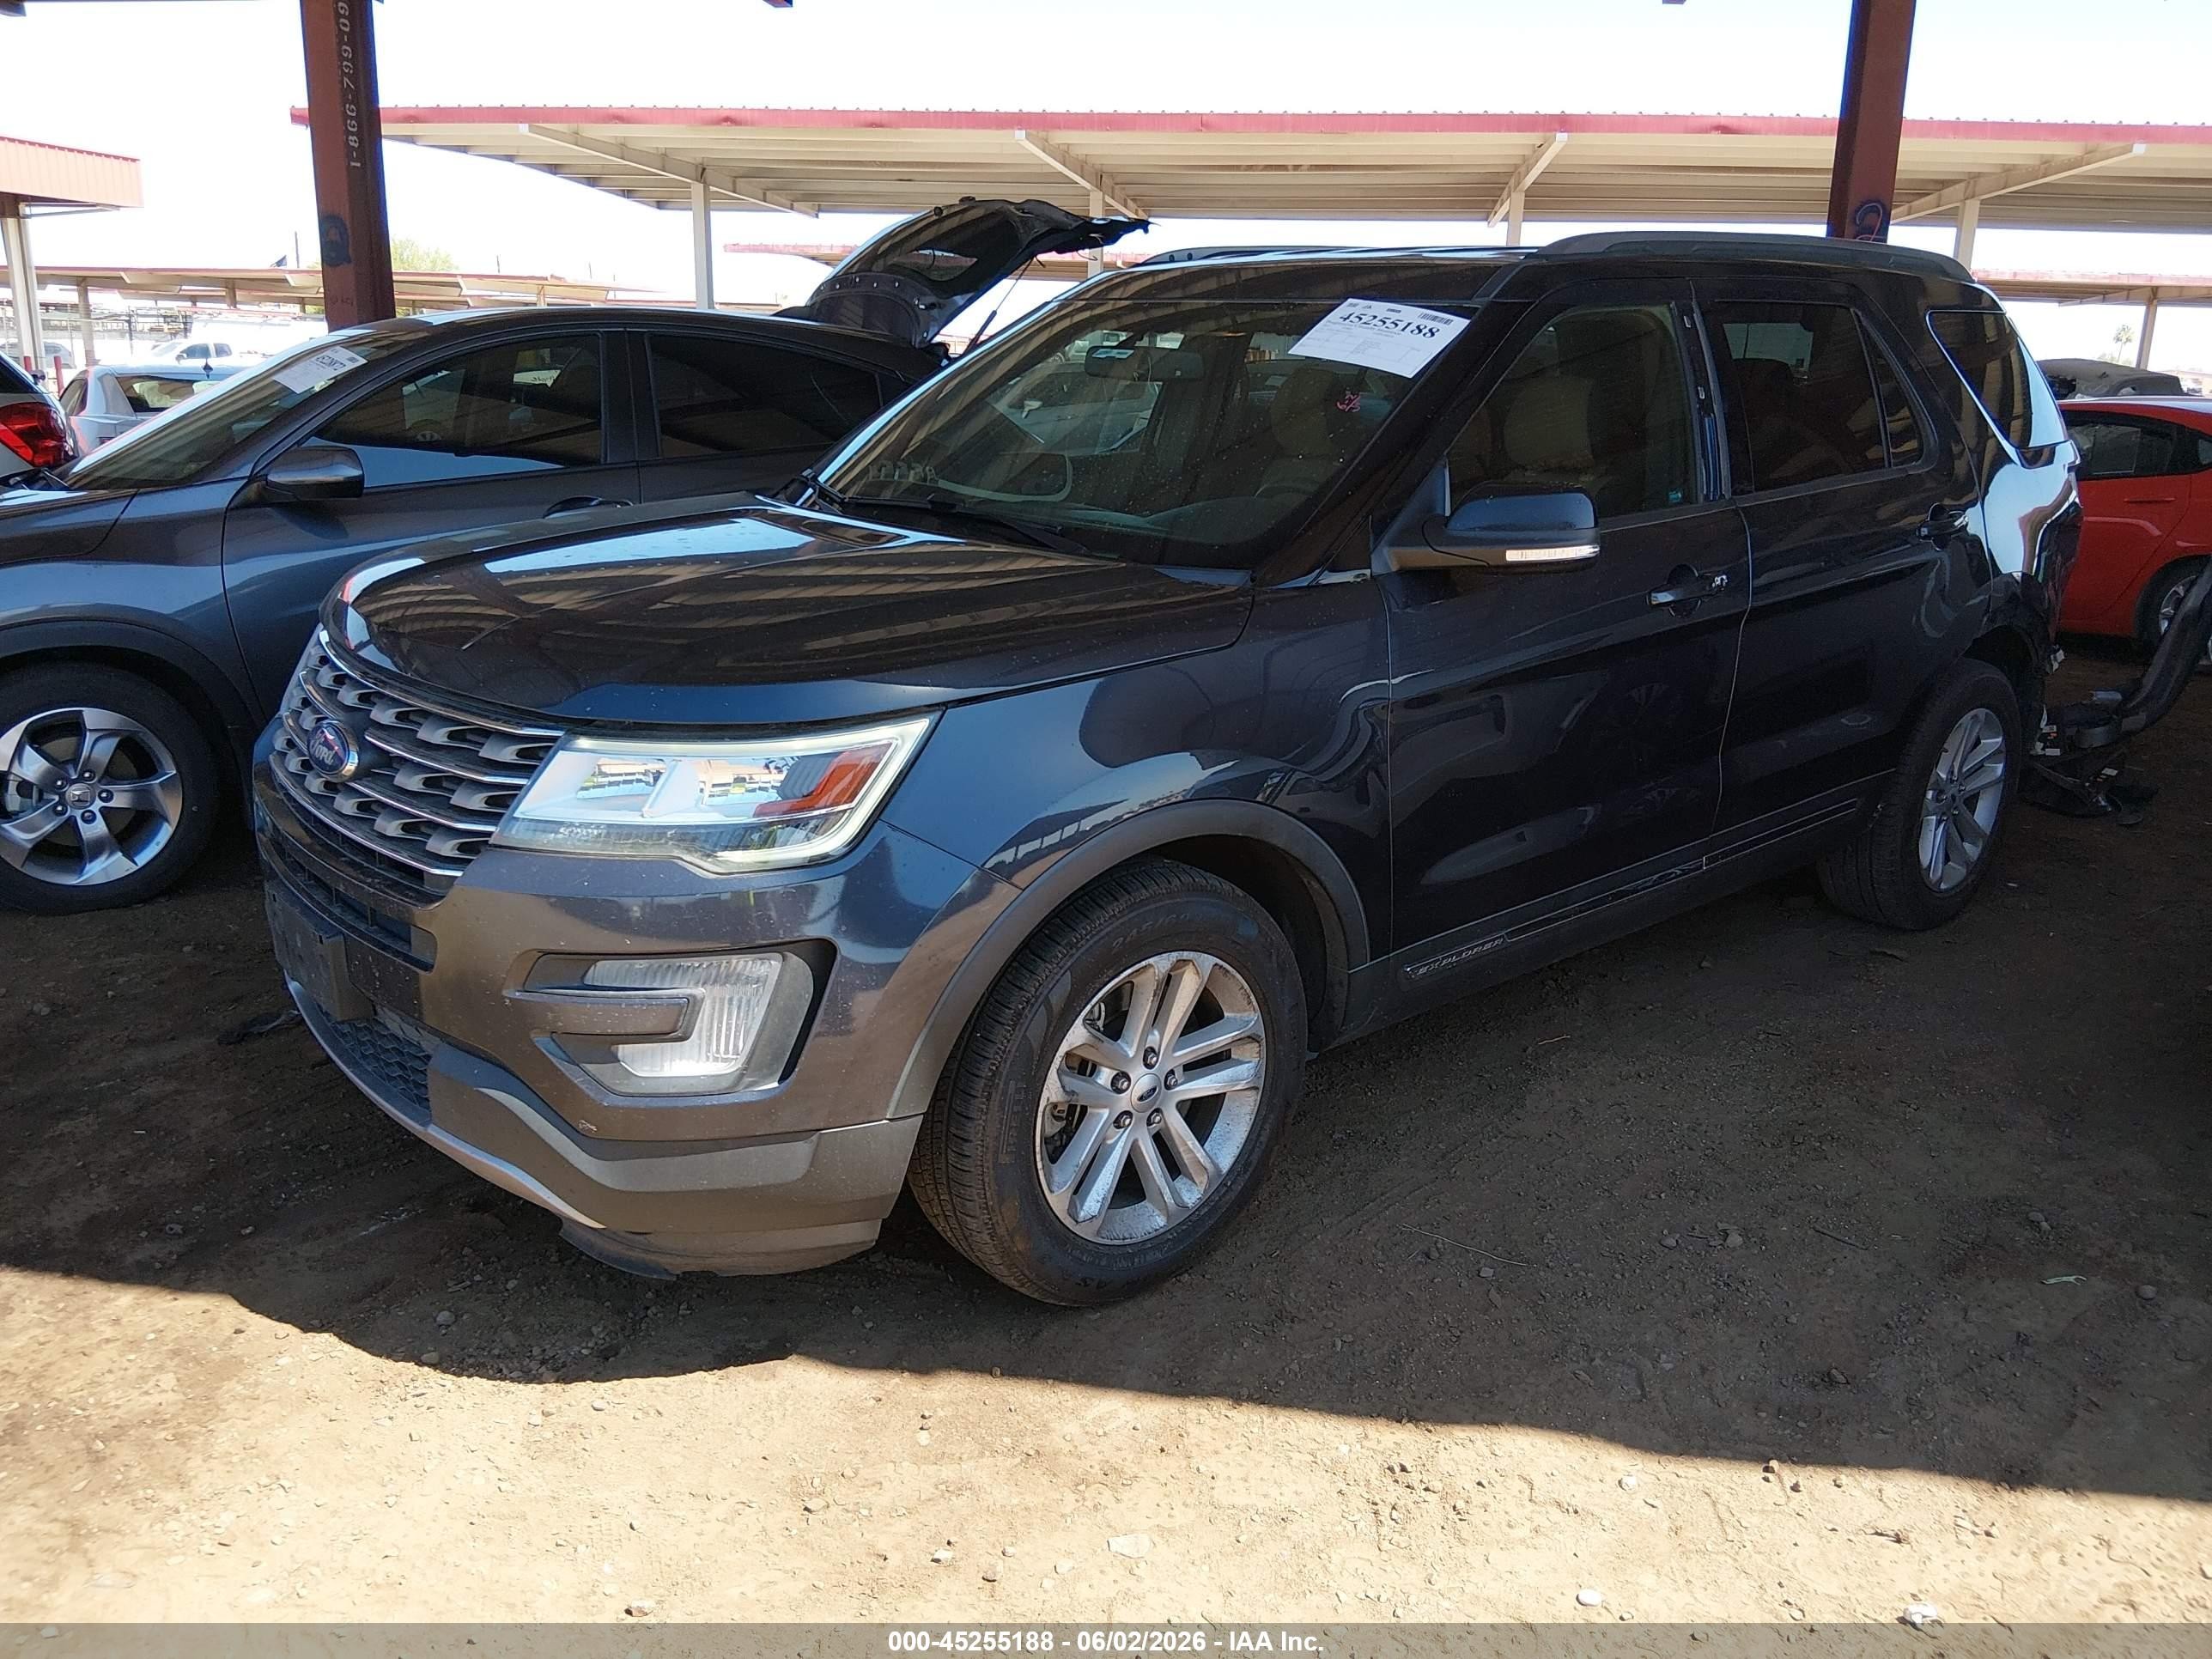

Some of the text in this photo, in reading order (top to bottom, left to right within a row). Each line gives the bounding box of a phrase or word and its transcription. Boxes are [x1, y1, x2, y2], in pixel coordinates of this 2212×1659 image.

[1339, 311, 1441, 339] 45255188
[309, 728, 336, 765] Ford
[1416, 937, 1504, 975] EXPLORER
